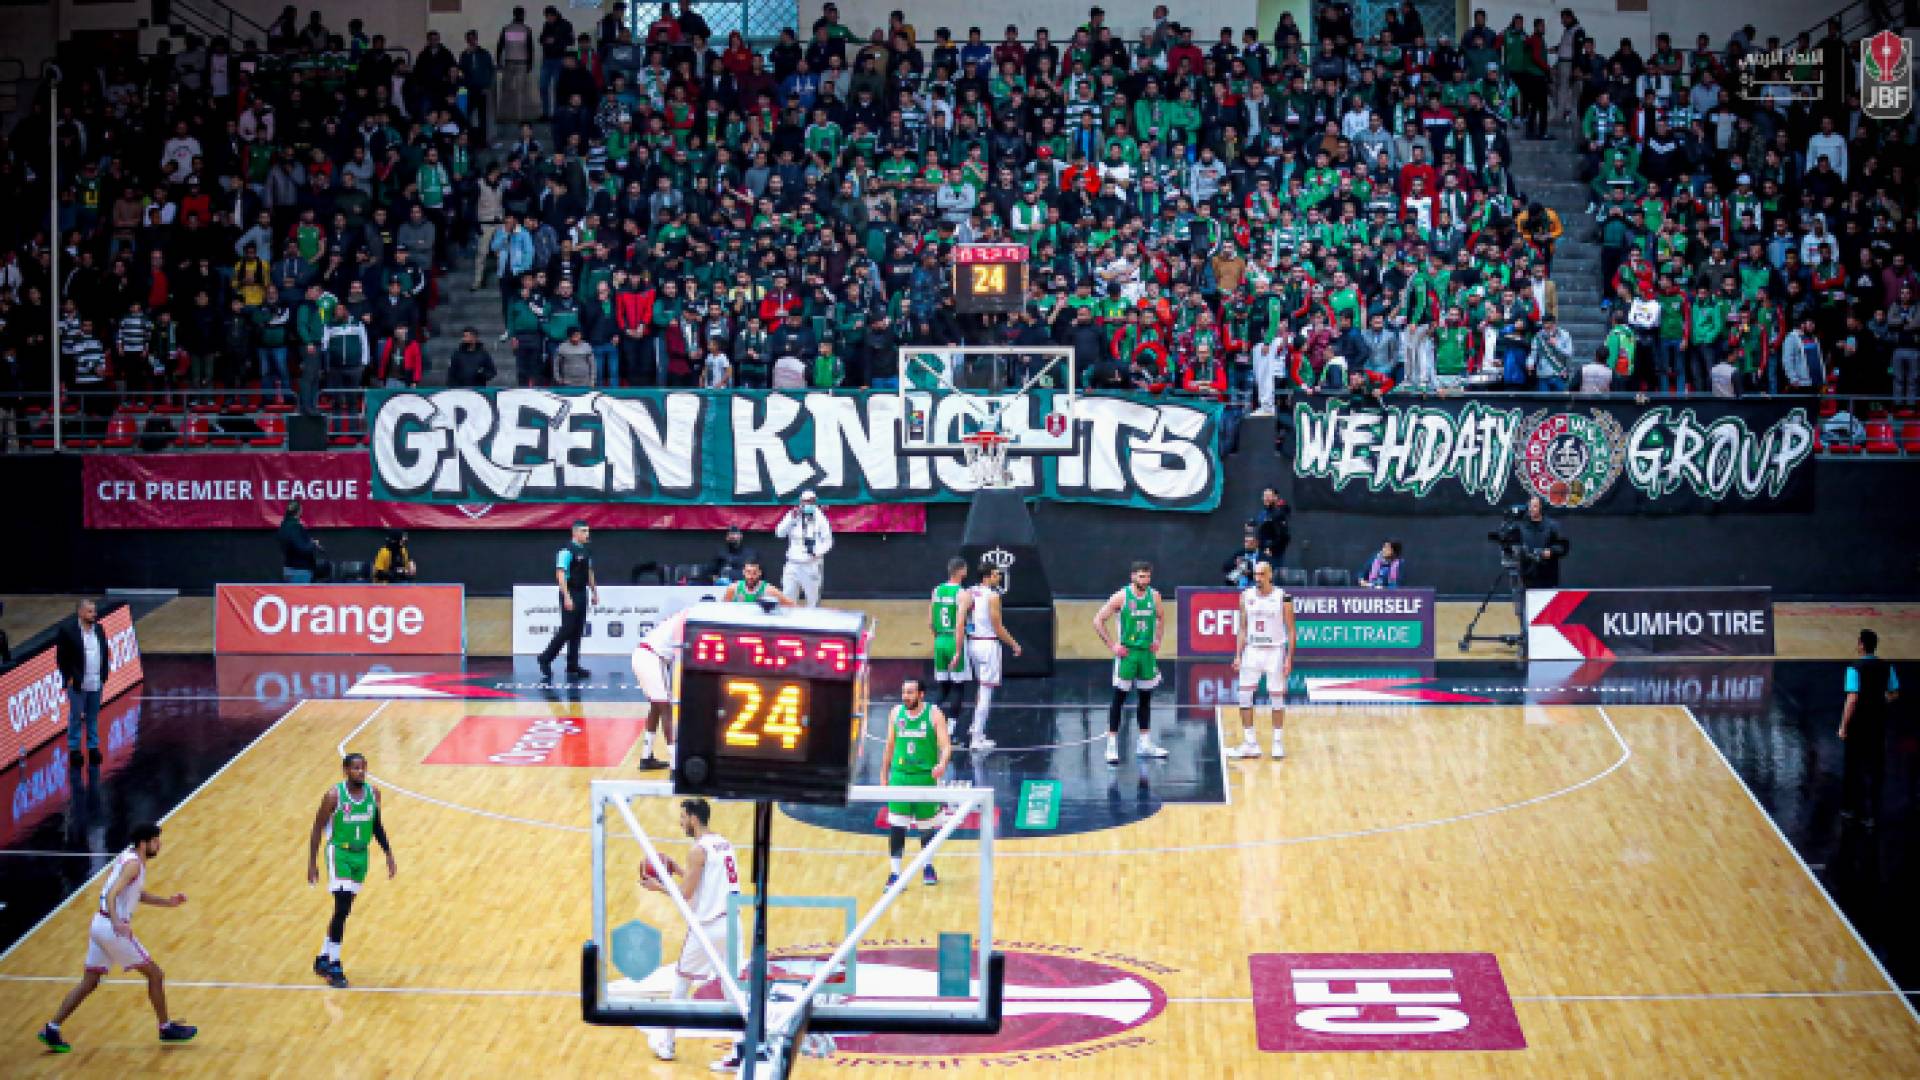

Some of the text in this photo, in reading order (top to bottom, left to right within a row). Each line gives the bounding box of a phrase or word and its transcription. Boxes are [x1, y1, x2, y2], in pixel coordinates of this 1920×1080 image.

[974, 266, 1004, 292] 24
[374, 389, 1209, 499] GREEN KNIGHTS
[1628, 409, 1812, 497] GROUP
[99, 480, 137, 500] CFI
[145, 480, 253, 500] PREMIER
[263, 480, 358, 500] LEAGUE
[253, 594, 425, 643] Orange
[1293, 597, 1337, 614] OWER
[1342, 597, 1424, 614] YOURSELF
[1604, 611, 1764, 635] KUMHO TIRE
[8, 667, 66, 733] orange
[725, 682, 802, 749] 24
[1291, 969, 1470, 1035] CFI
